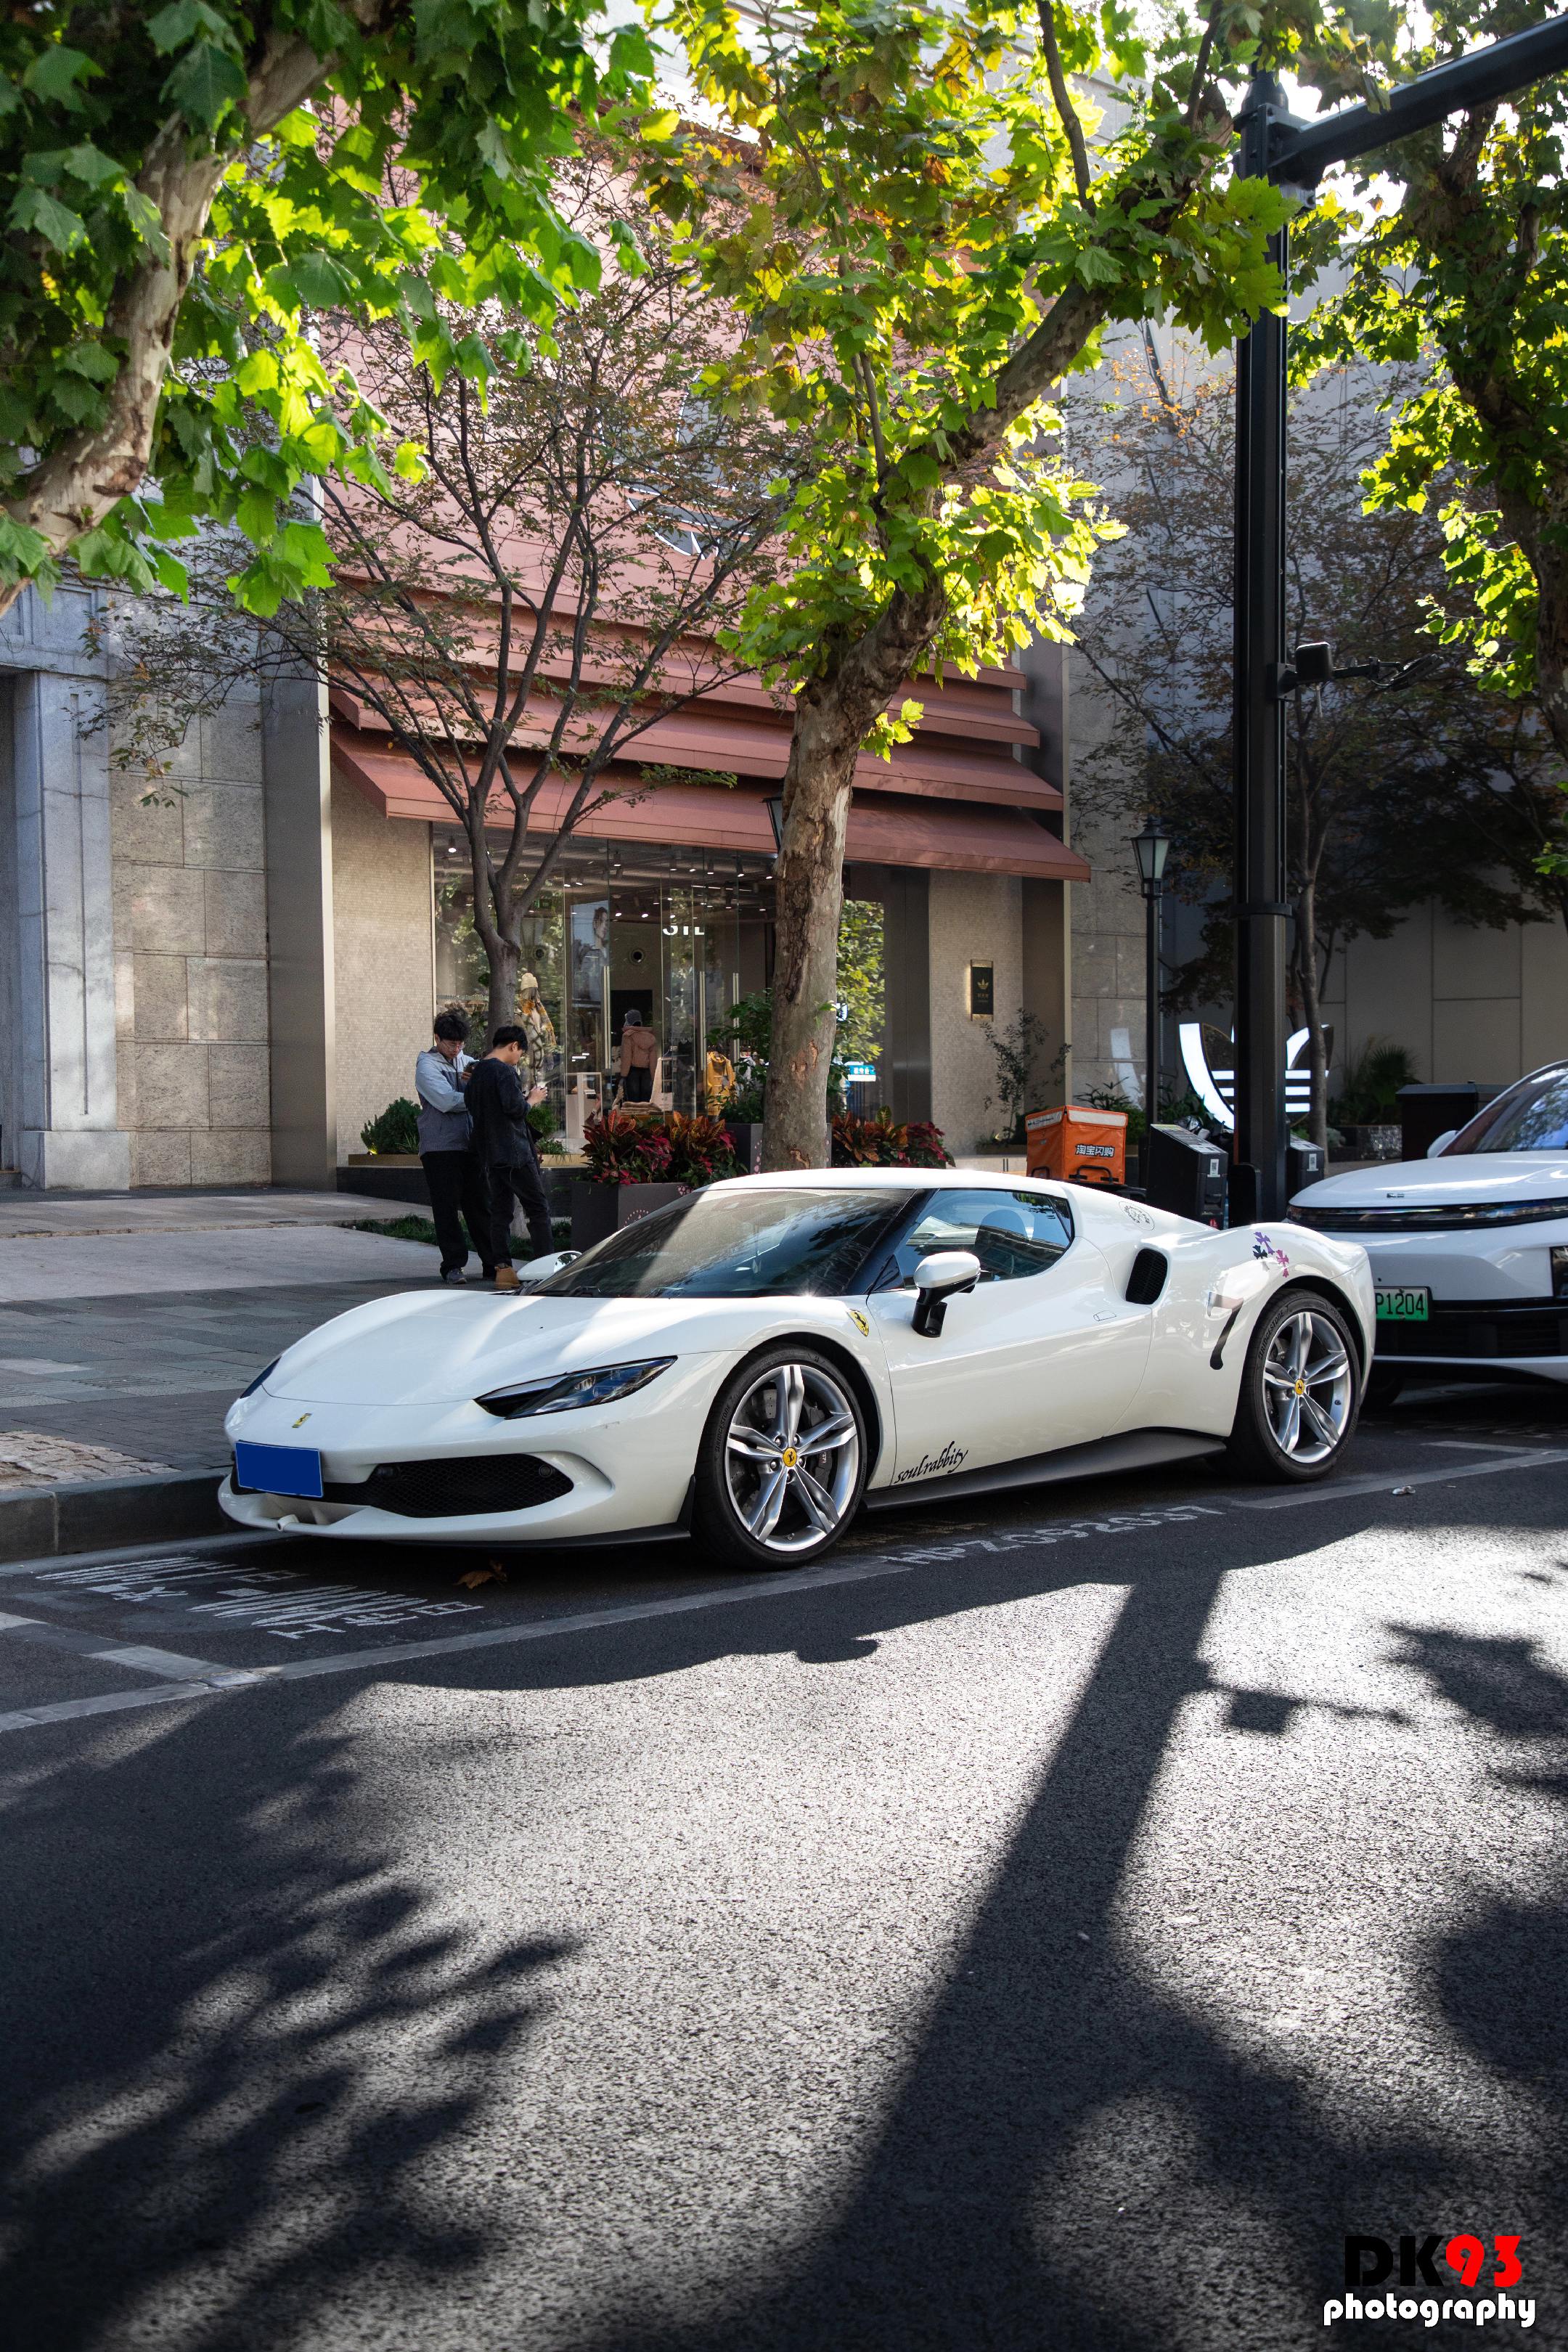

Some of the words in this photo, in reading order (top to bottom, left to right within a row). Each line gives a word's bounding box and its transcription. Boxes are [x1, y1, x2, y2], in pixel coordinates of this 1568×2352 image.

[1075, 1144, 1115, 1158] 淘宝闪购
[1376, 1292, 1425, 1315] P1204
[894, 1440, 968, 1483] soulrabbity
